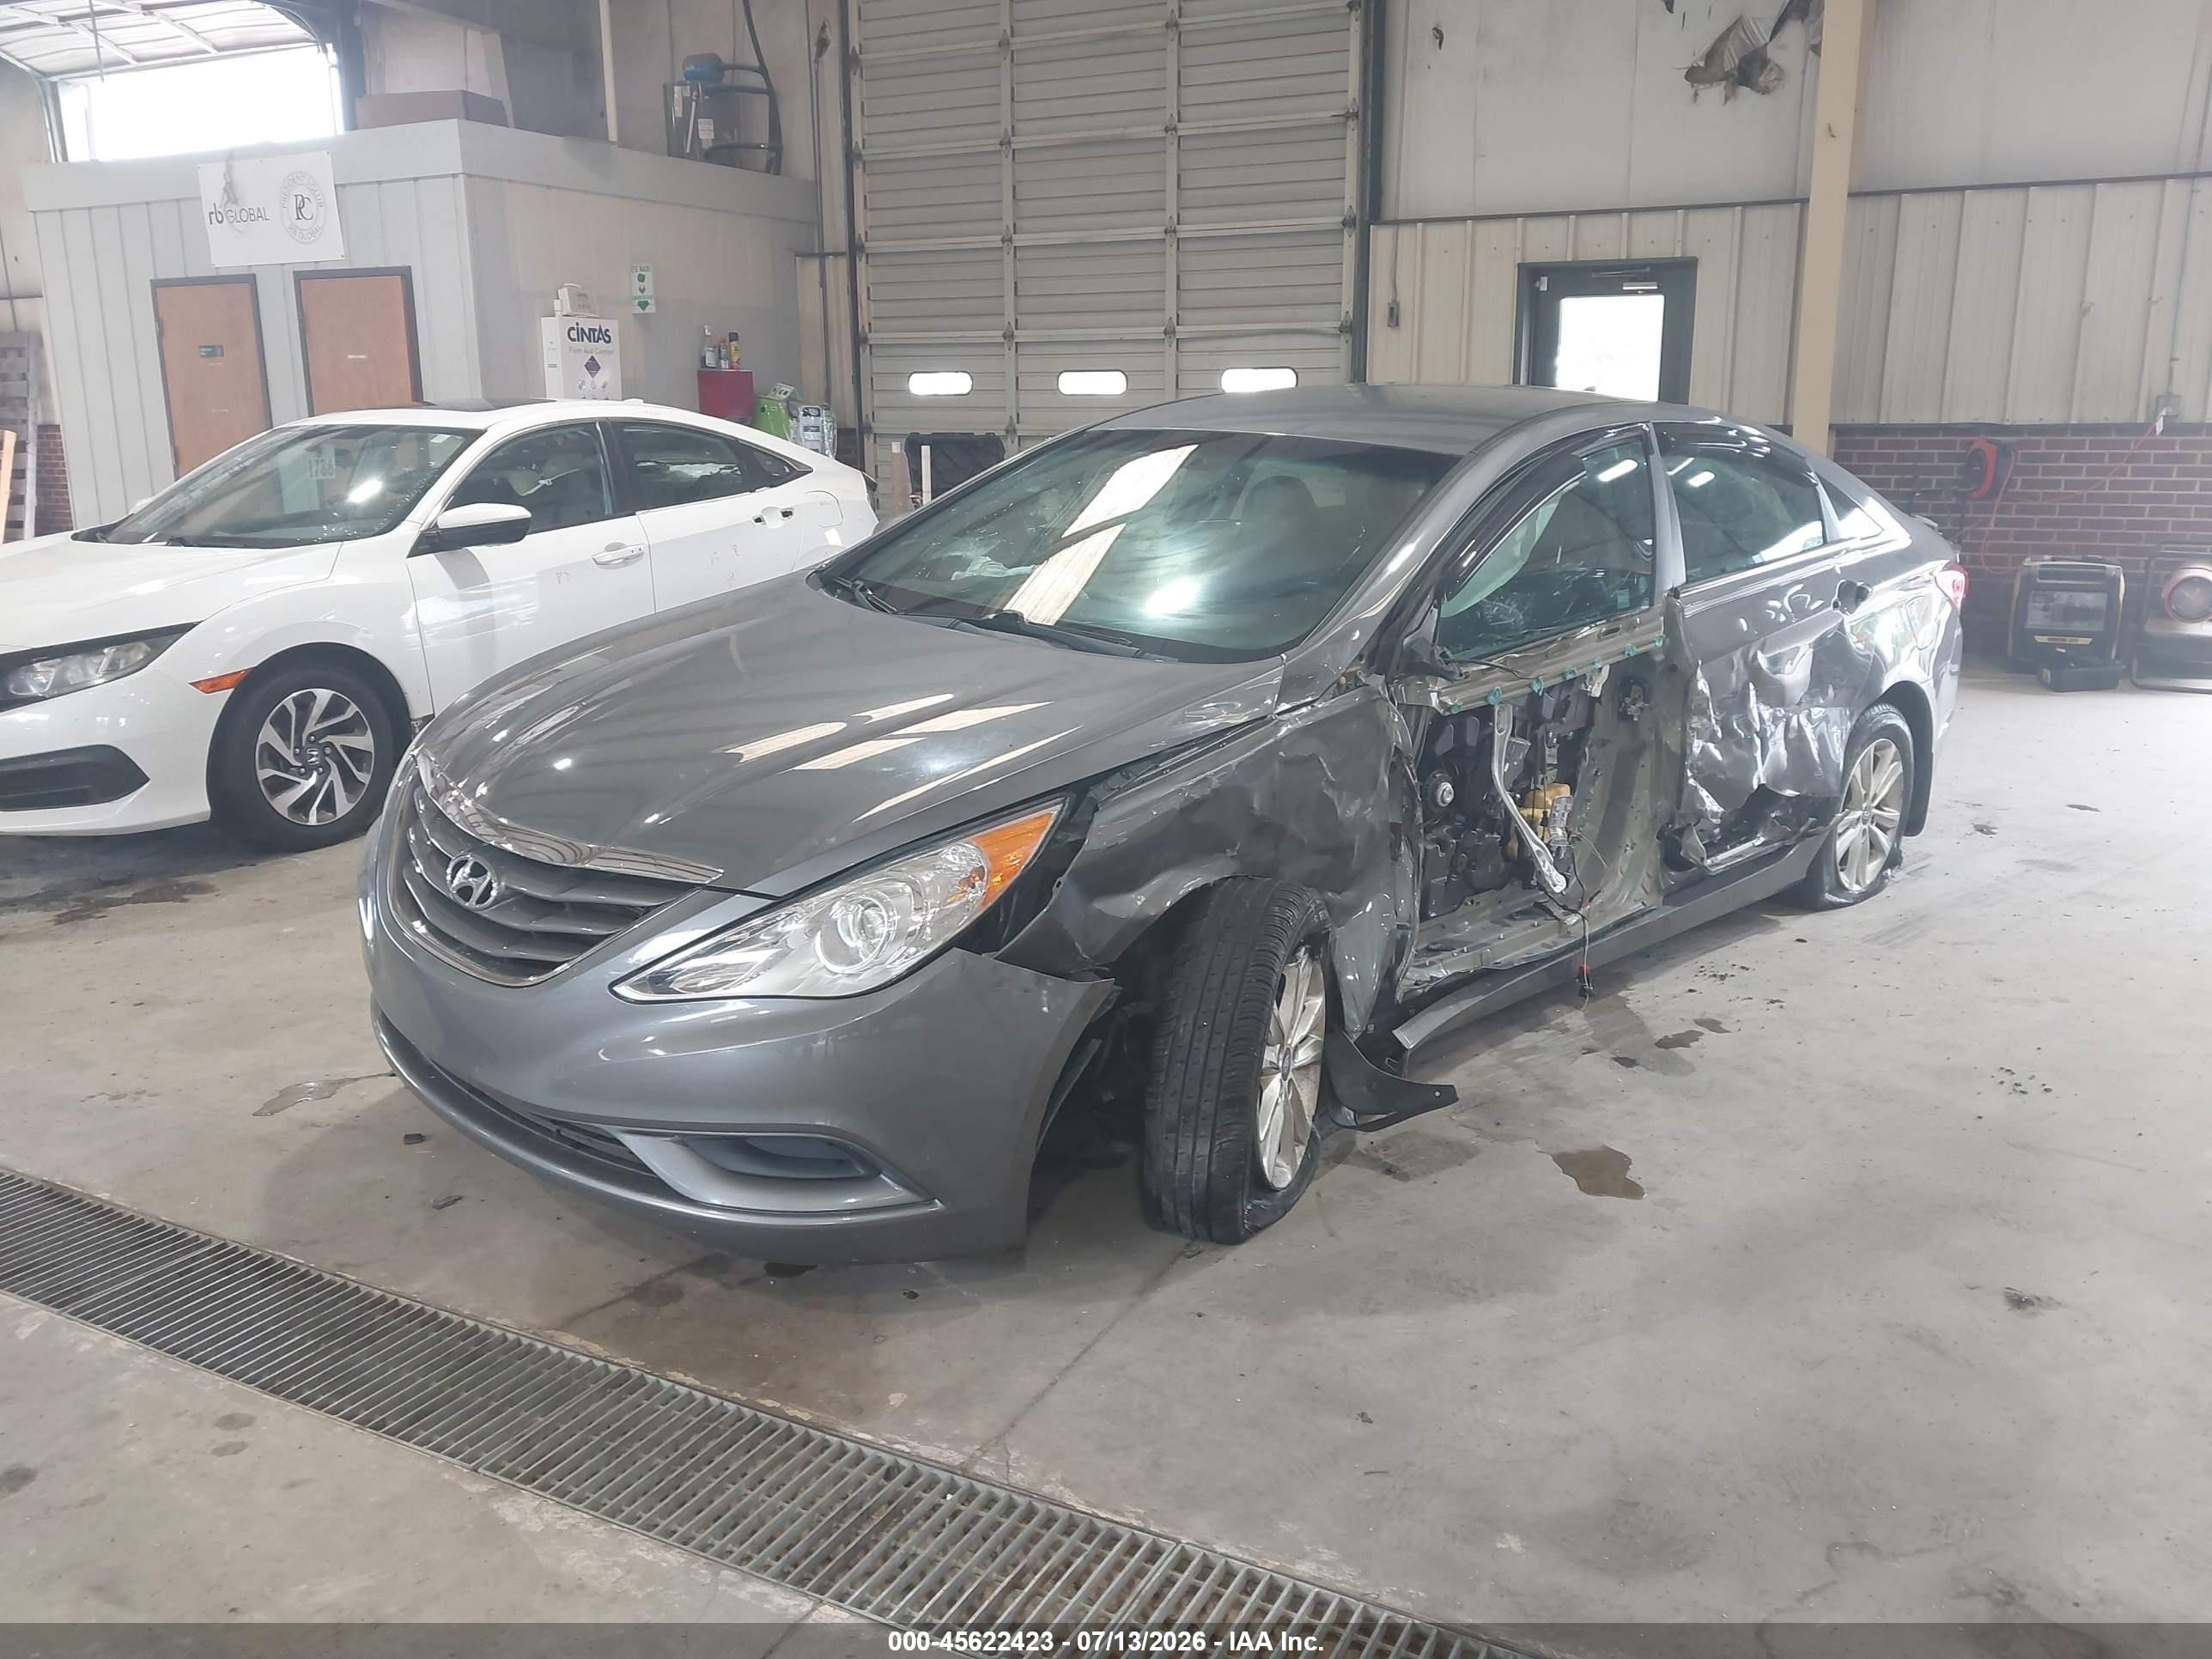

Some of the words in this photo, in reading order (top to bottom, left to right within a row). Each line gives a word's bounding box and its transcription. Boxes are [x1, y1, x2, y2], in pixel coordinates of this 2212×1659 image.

[209, 202, 225, 225] rb
[226, 207, 270, 224] GLOBAL
[567, 321, 612, 344] CINTAS
